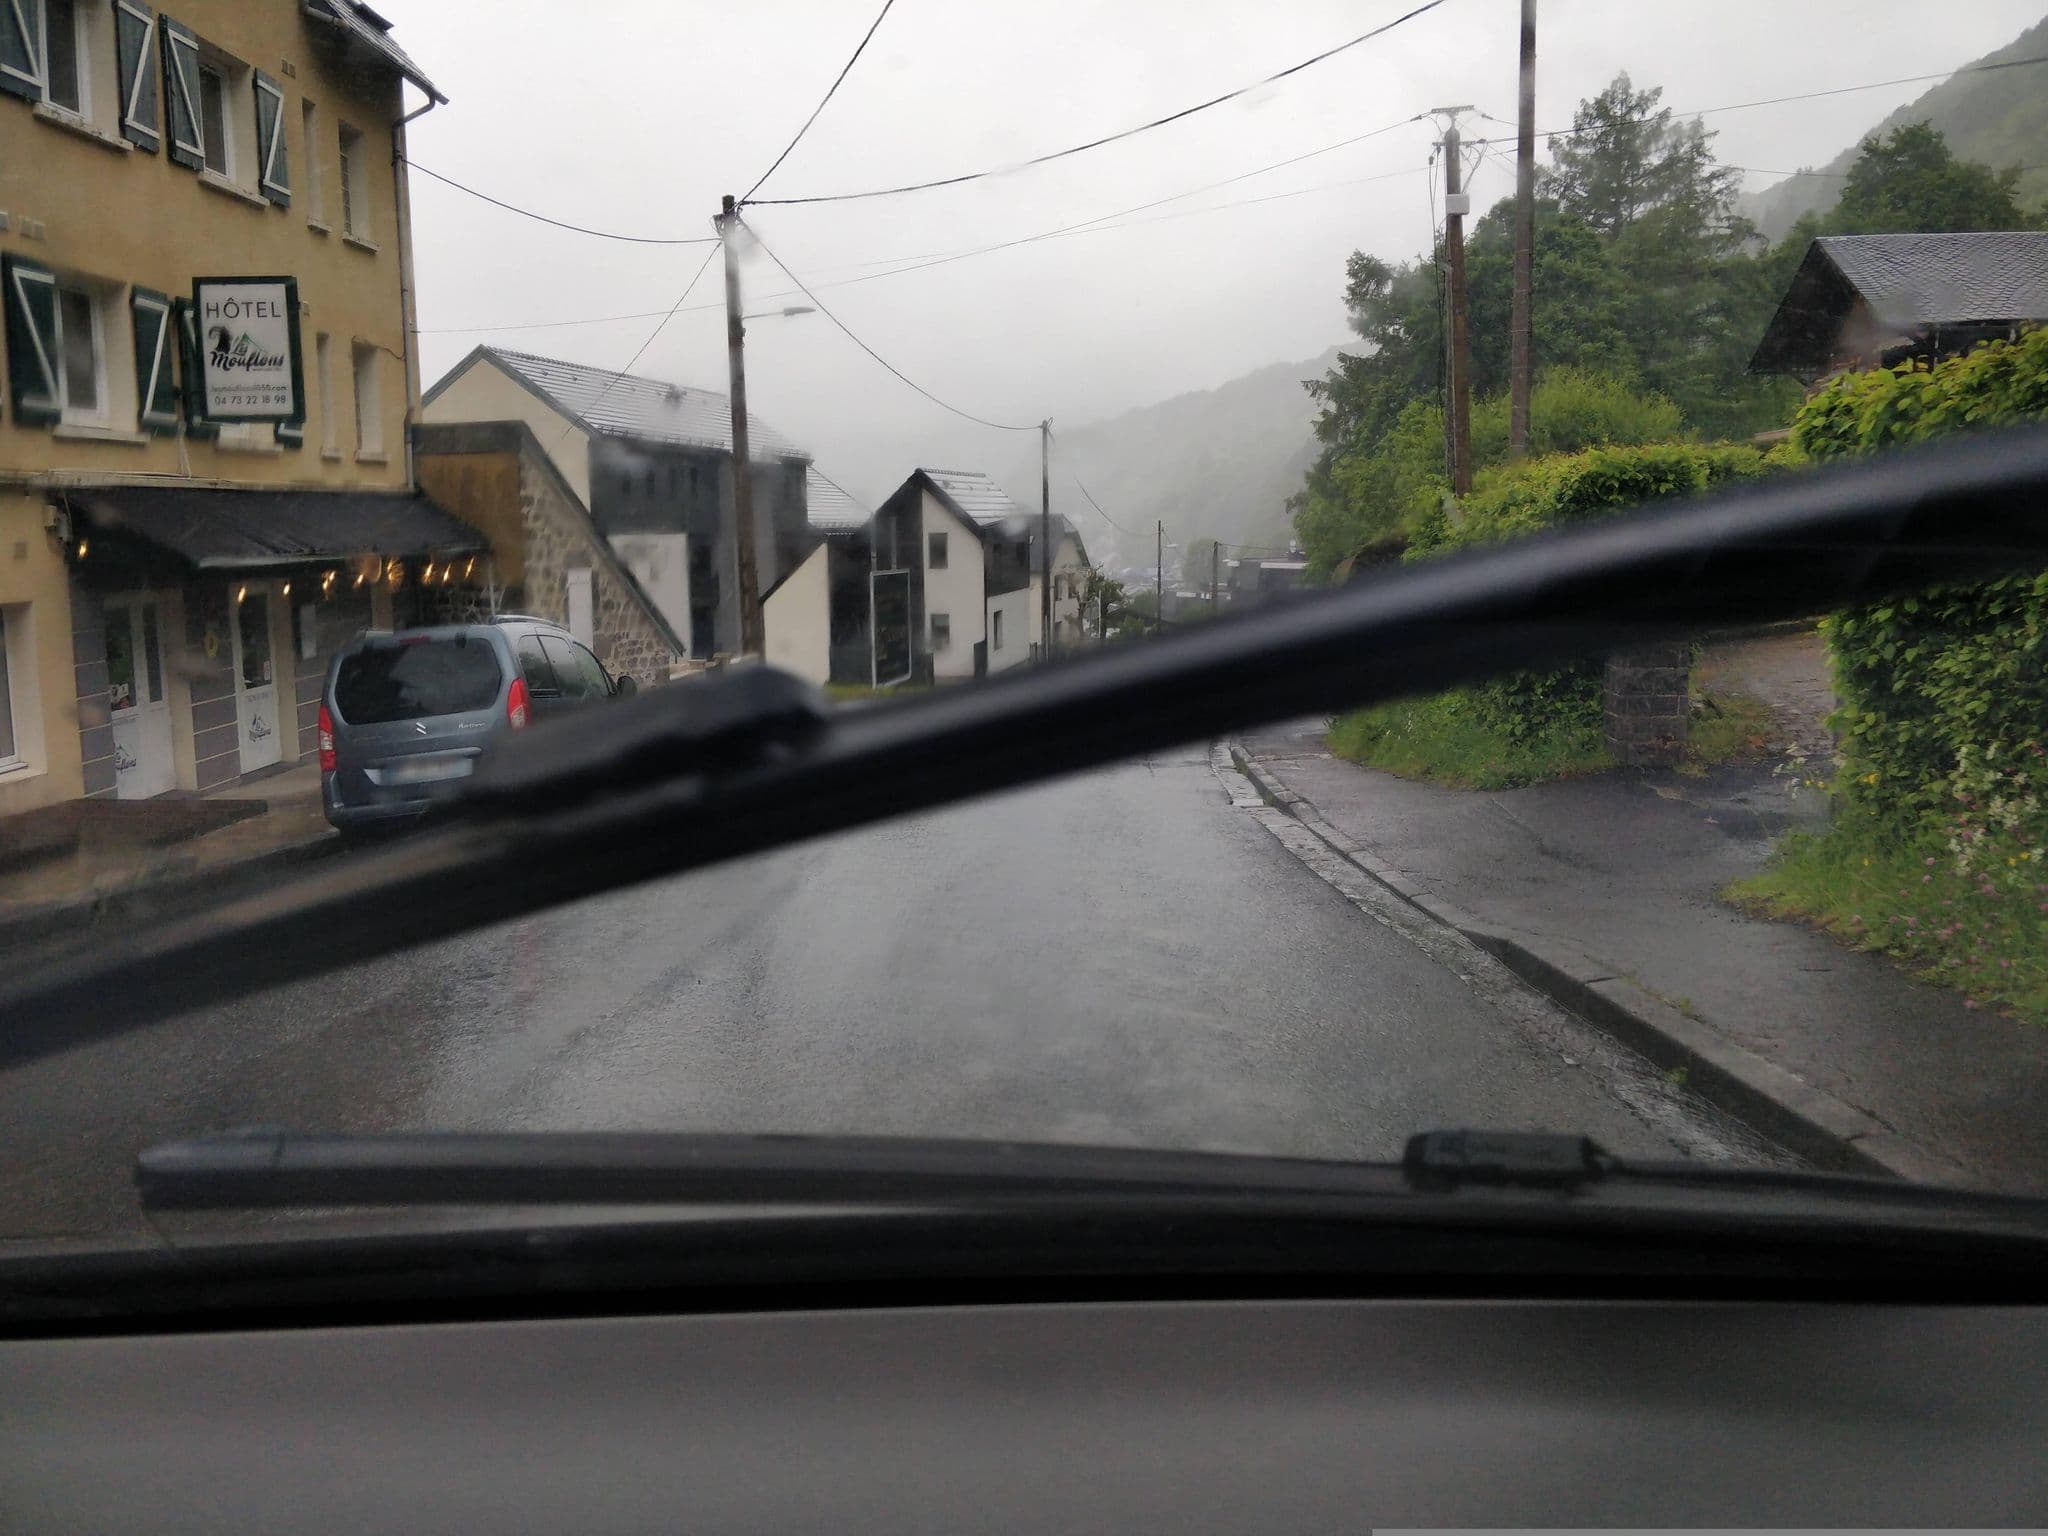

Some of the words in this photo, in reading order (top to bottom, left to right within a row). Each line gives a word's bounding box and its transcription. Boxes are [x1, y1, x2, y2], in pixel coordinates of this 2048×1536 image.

[206, 297, 281, 319] HÔTEL
[210, 351, 284, 371] Mouflons
[214, 396, 227, 405] 04
[231, 395, 242, 405] 73
[246, 395, 257, 405] 22
[274, 394, 287, 404] 98
